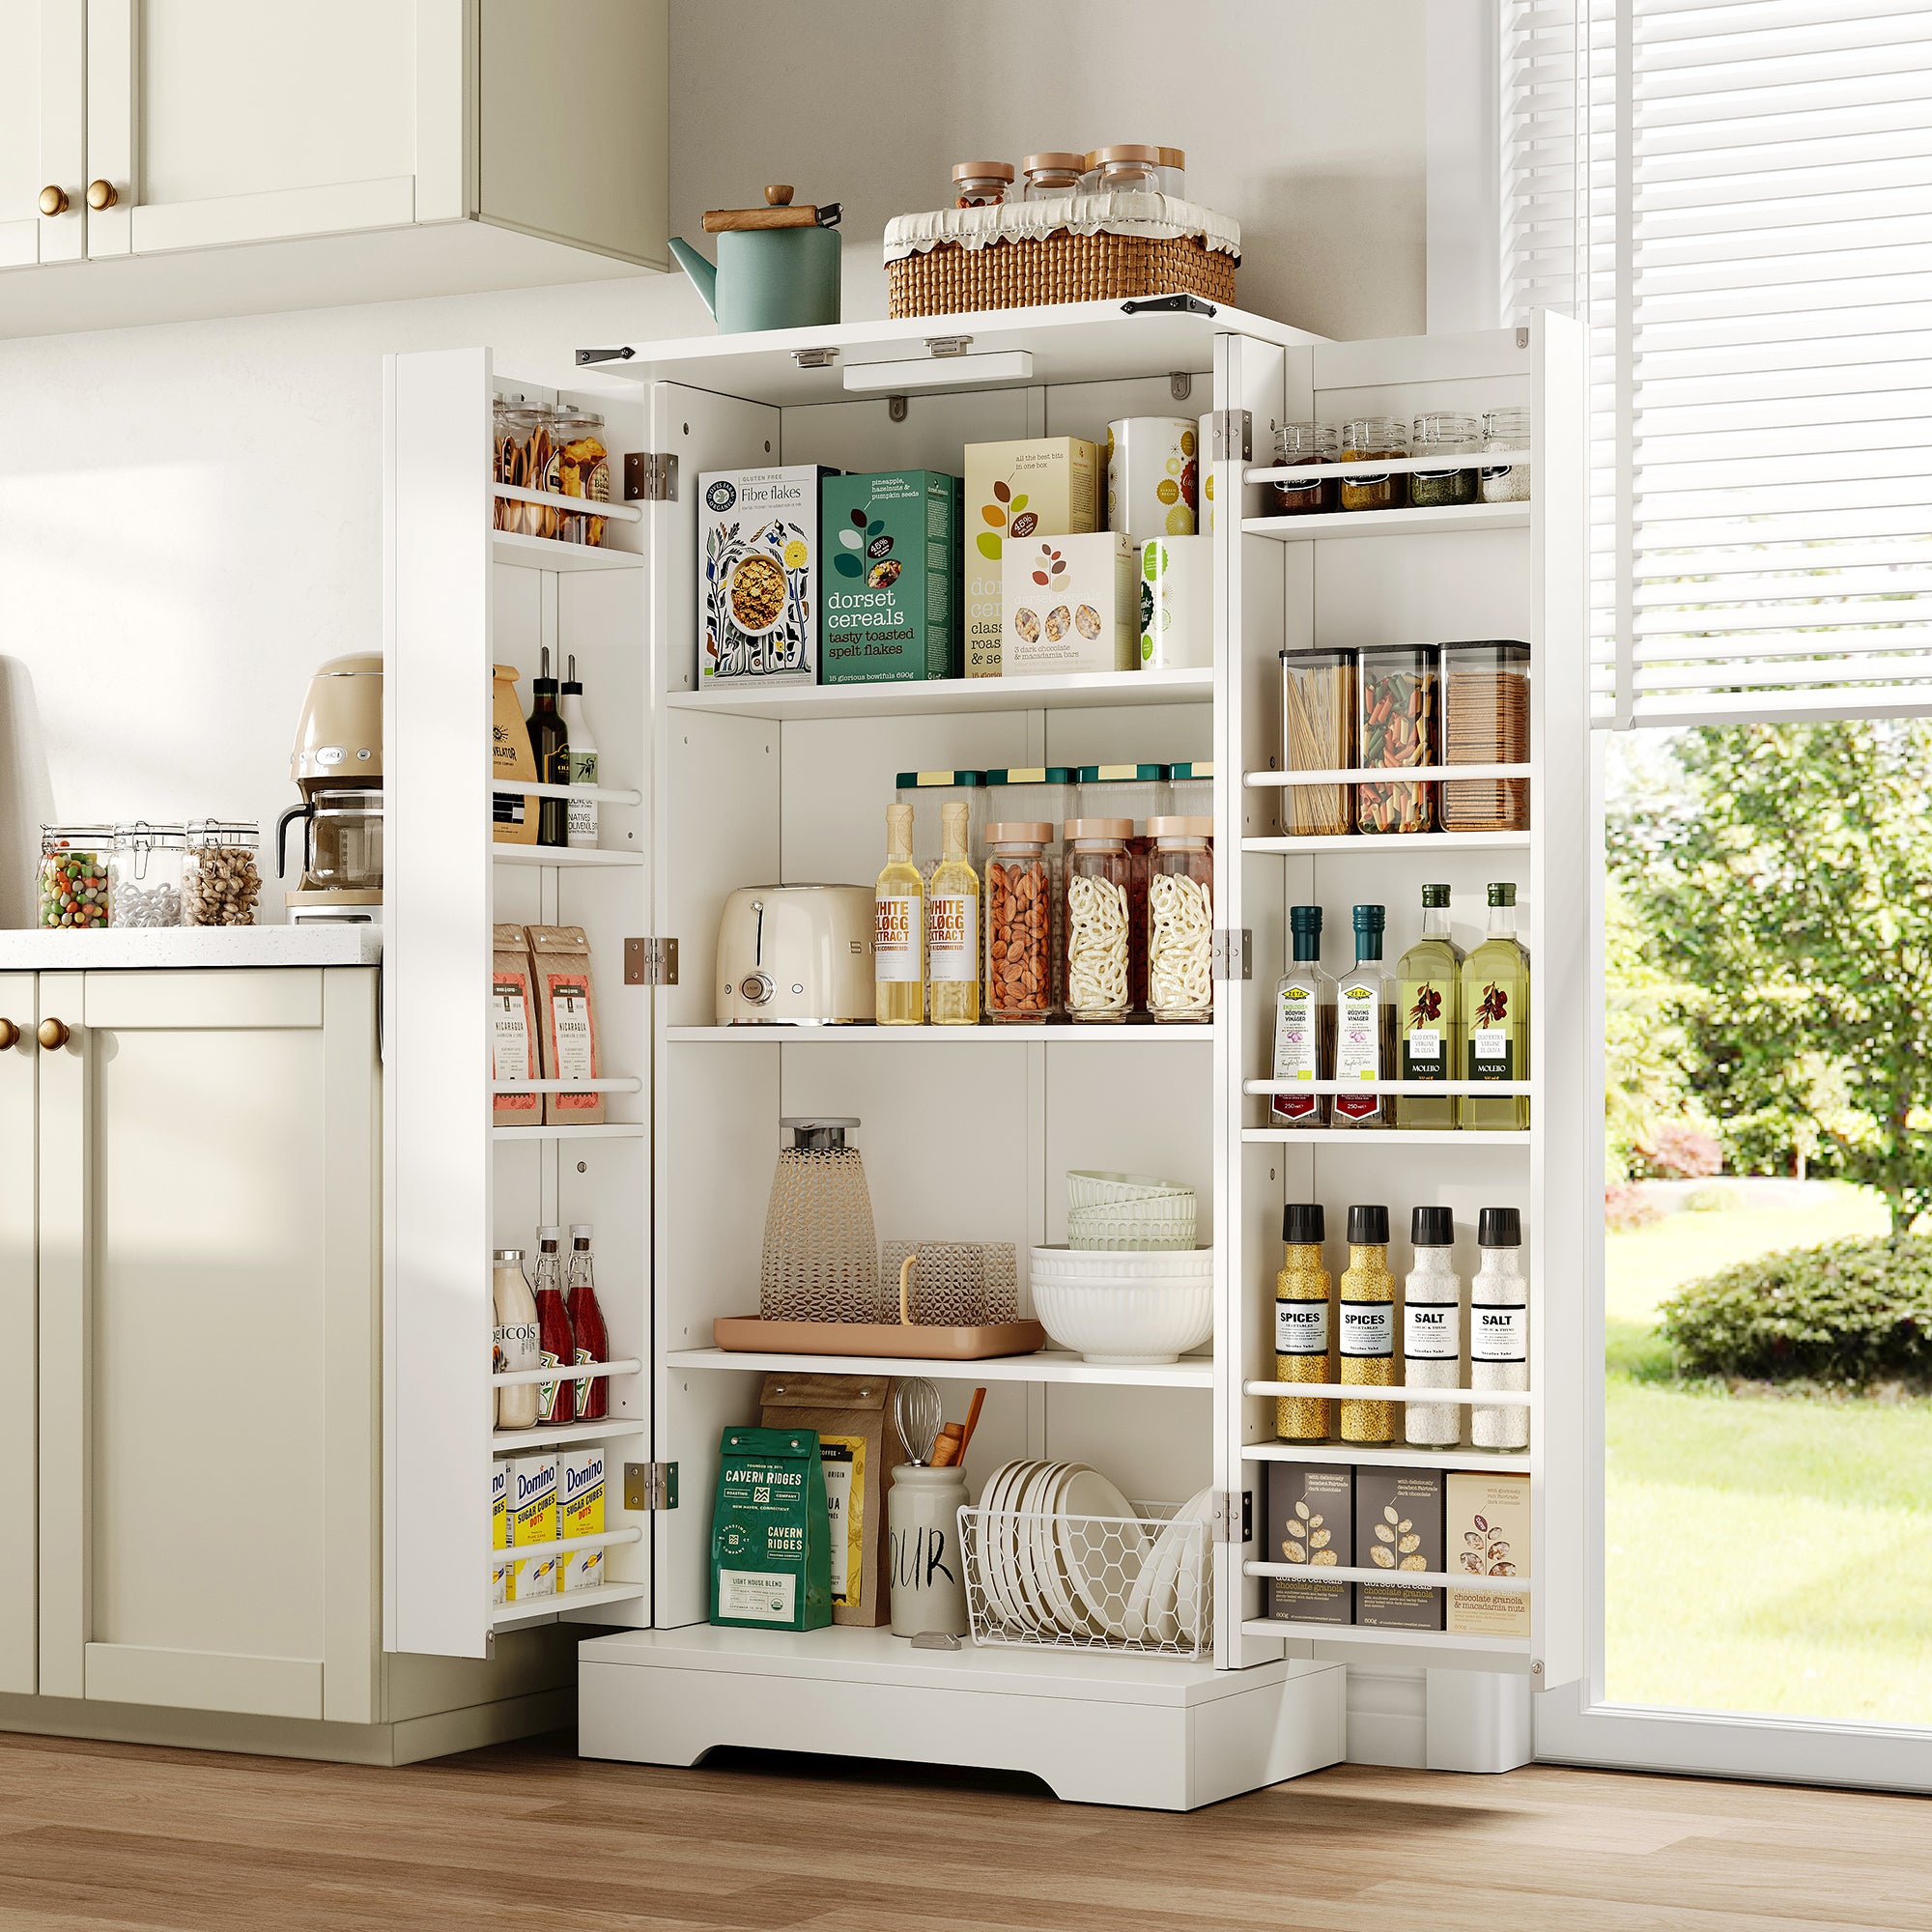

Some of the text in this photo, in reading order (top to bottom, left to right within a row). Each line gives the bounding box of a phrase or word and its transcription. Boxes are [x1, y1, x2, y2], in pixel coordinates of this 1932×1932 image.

[742, 485, 801, 501] Fibre flakes
[710, 499, 733, 511] ORGANIC
[828, 590, 895, 610] dorset
[828, 609, 904, 628] cereals
[830, 628, 915, 644] tasty toasted
[972, 639, 1003, 649] roas
[829, 643, 903, 659] spelt flakes
[972, 653, 982, 665] &
[875, 916, 908, 930] LØGG
[930, 915, 964, 929] LØGG
[496, 1022, 524, 1031] NICARAGUA
[559, 1023, 586, 1032] NICARAGUA
[1281, 1313, 1320, 1322] SPICES
[1346, 1315, 1385, 1325] SPICES
[1415, 1314, 1444, 1323] SALT
[1483, 1316, 1512, 1325] SALT
[566, 1460, 603, 1492] Domino
[726, 1470, 802, 1485] CAVERN RIDGES
[517, 1466, 554, 1500] Domino
[567, 1488, 603, 1517] SUGAR CUBES
[518, 1494, 555, 1524] SUGAR CUBES
[579, 1505, 592, 1520] DOTS
[530, 1513, 544, 1527] DOTS
[768, 1526, 803, 1538] CAVERN
[768, 1539, 803, 1550] RIDGES
[1276, 1581, 1345, 1593] chocolate granola
[1364, 1587, 1401, 1596] chocolate
[1455, 1594, 1491, 1603] chocolate
[1463, 1603, 1506, 1611] macadamia
